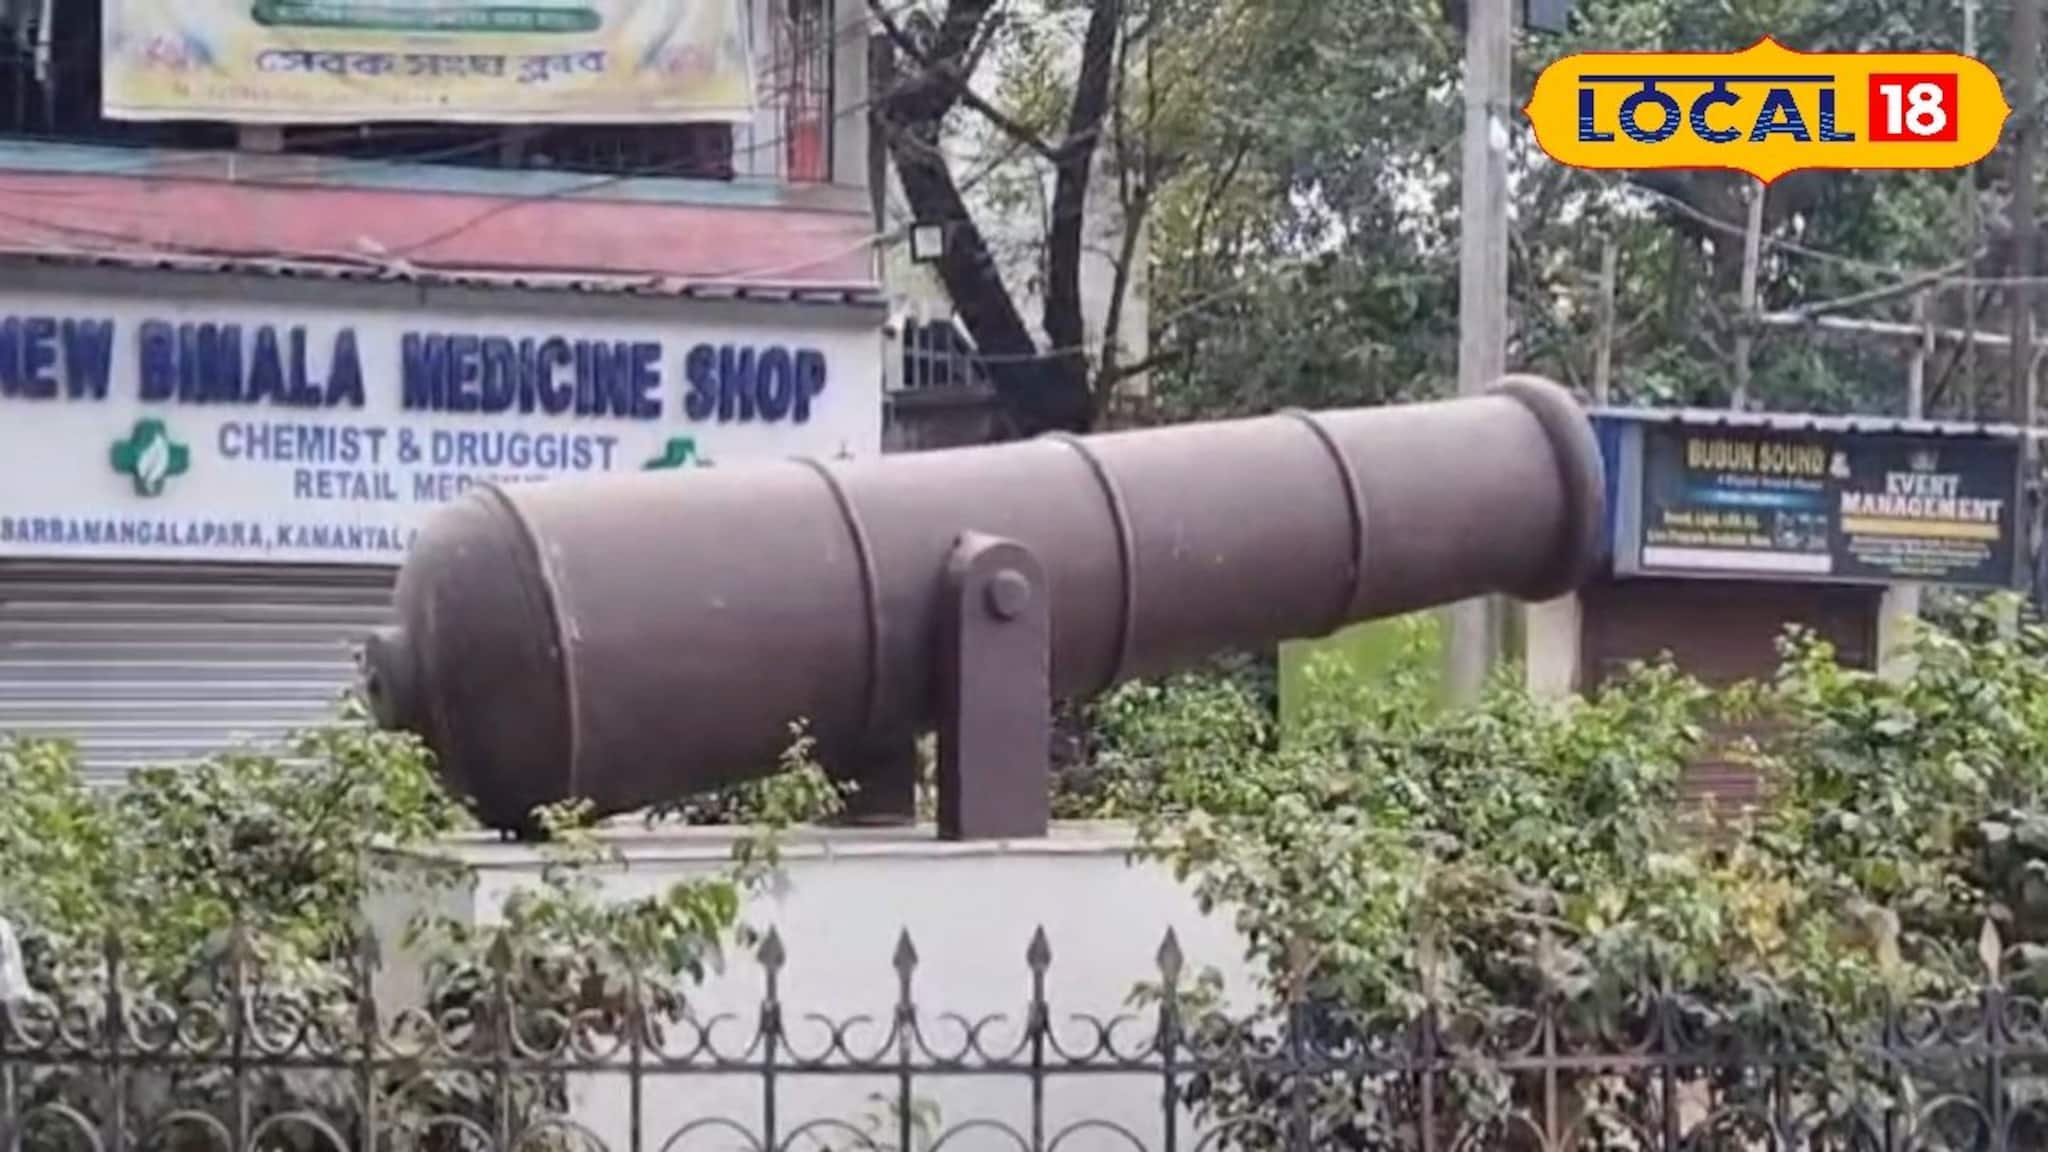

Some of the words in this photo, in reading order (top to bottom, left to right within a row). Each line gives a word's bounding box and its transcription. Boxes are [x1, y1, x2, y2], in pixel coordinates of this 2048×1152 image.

[139, 318, 366, 409] BIMALA
[401, 332, 663, 420] MEDICINE
[684, 342, 827, 424] SHOP
[217, 422, 387, 465] CHEMIST
[396, 428, 421, 464] &
[431, 429, 619, 471] DRUGGIST
[1758, 442, 1825, 474] SOUND
[1829, 451, 1851, 478] &
[293, 469, 398, 502] RETAIL
[1885, 471, 1961, 497] EVENT
[1840, 491, 2004, 522] MANAGEMENT
